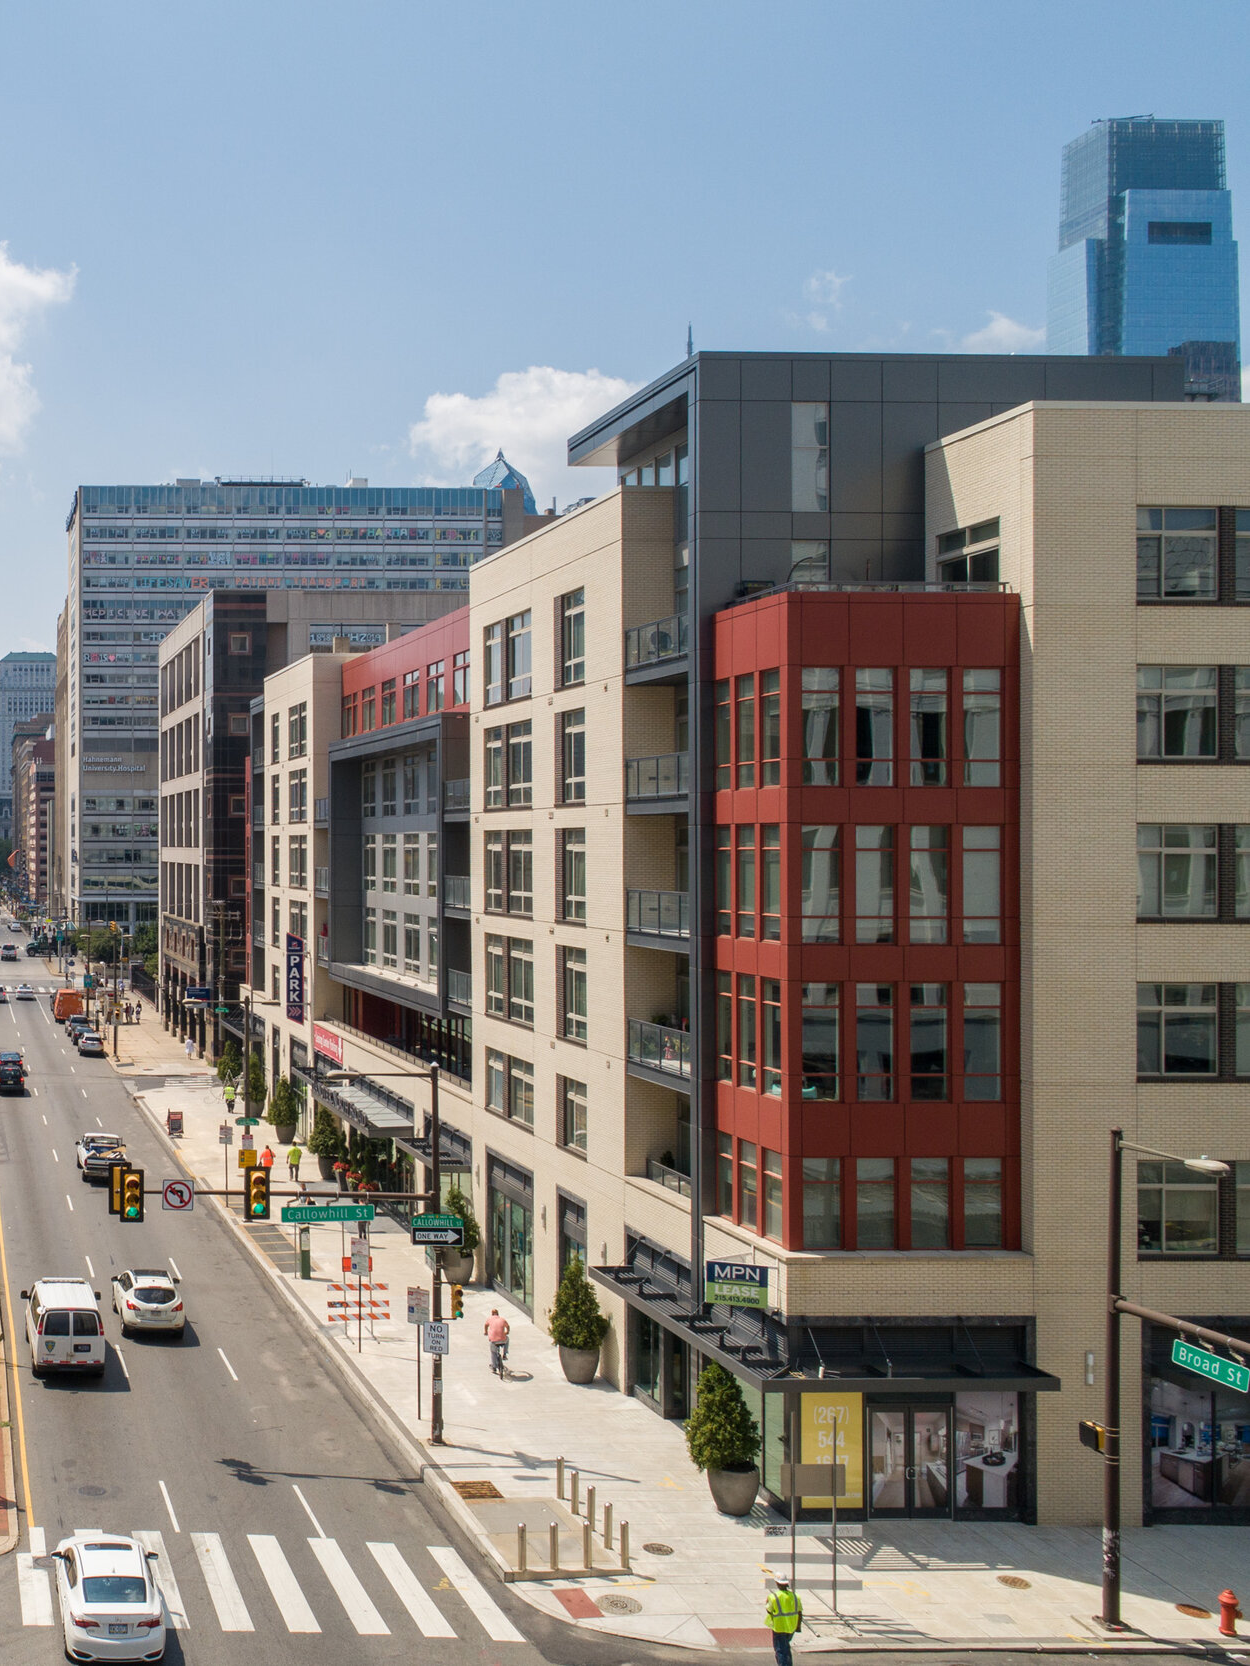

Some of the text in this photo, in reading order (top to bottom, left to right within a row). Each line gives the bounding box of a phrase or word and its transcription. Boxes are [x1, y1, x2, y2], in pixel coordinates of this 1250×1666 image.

[133, 576, 208, 588] LIFESAVER
[235, 577, 282, 585] PATIENT
[82, 764, 146, 774] University Hospital
[289, 955, 301, 1002] PARK
[287, 1207, 368, 1220] Callowhill St
[412, 1218, 454, 1227] CALLOWHILL
[416, 1232, 449, 1240] ONE WAY
[714, 1264, 760, 1281] MPN
[714, 1284, 760, 1298] LEASE
[430, 1324, 443, 1333] NO
[428, 1332, 445, 1340] TURN
[1179, 1347, 1242, 1385] Broad St
[814, 1406, 850, 1425] (267)
[818, 1430, 845, 1448] 544
